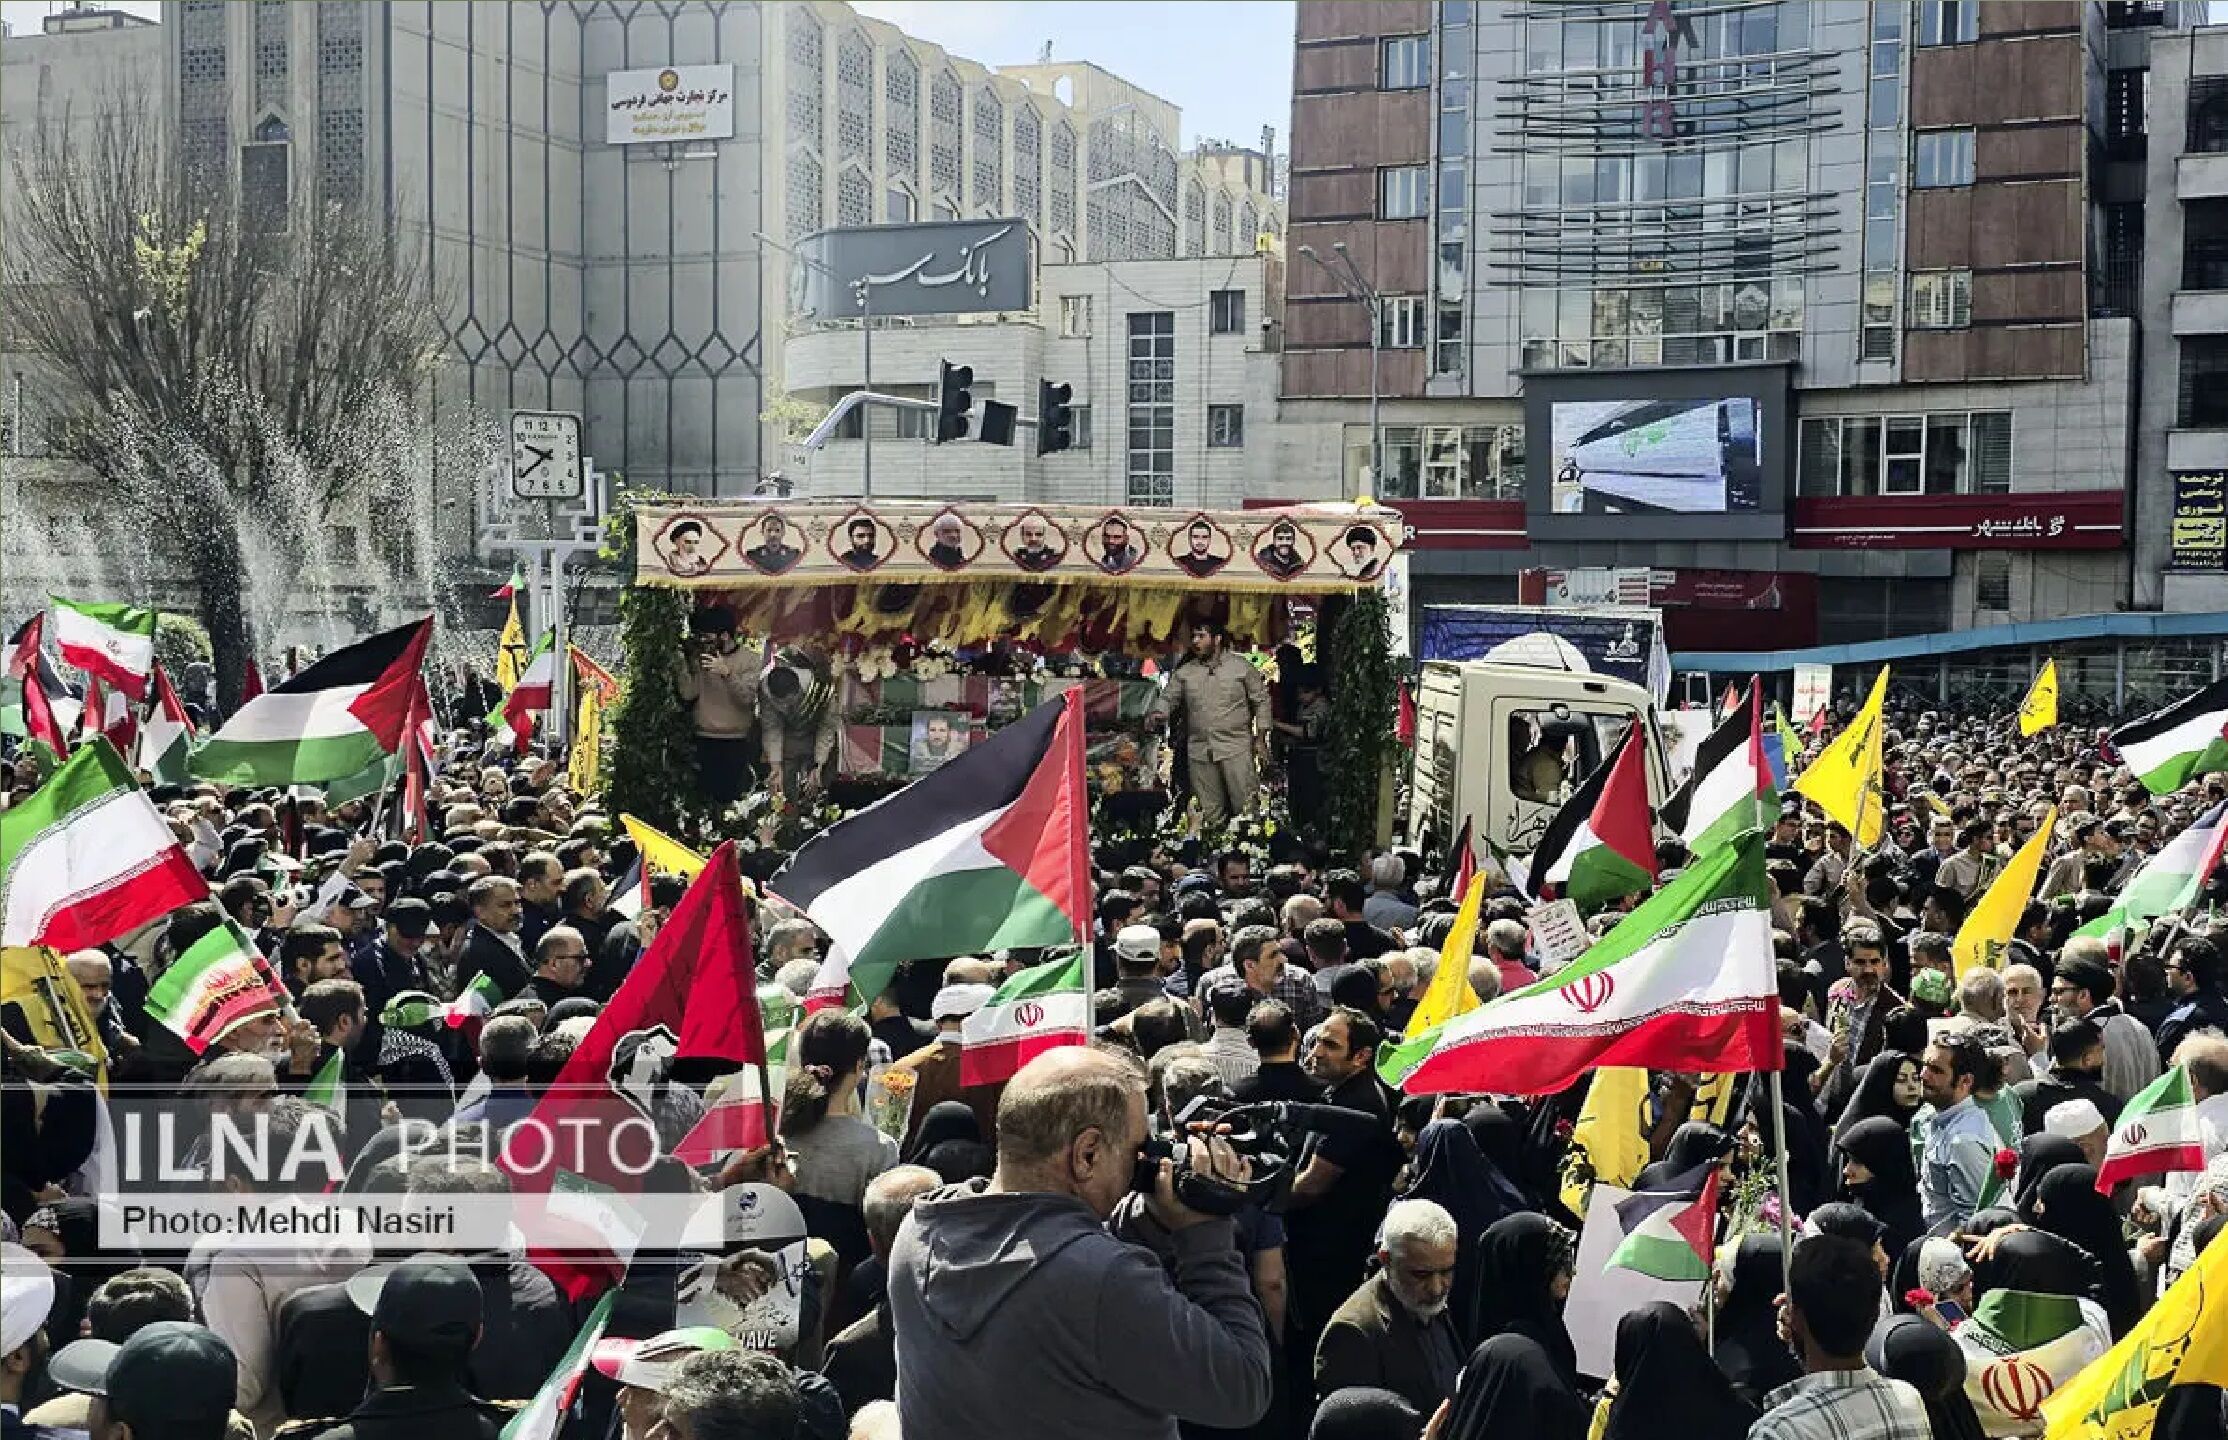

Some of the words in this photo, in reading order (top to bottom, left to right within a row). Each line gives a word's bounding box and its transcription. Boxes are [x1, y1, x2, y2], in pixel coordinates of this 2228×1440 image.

[848, 252, 937, 307] سپه
[917, 225, 1013, 297] بانک
[1972, 519, 2012, 537] شهر
[2012, 515, 2043, 537] بانک
